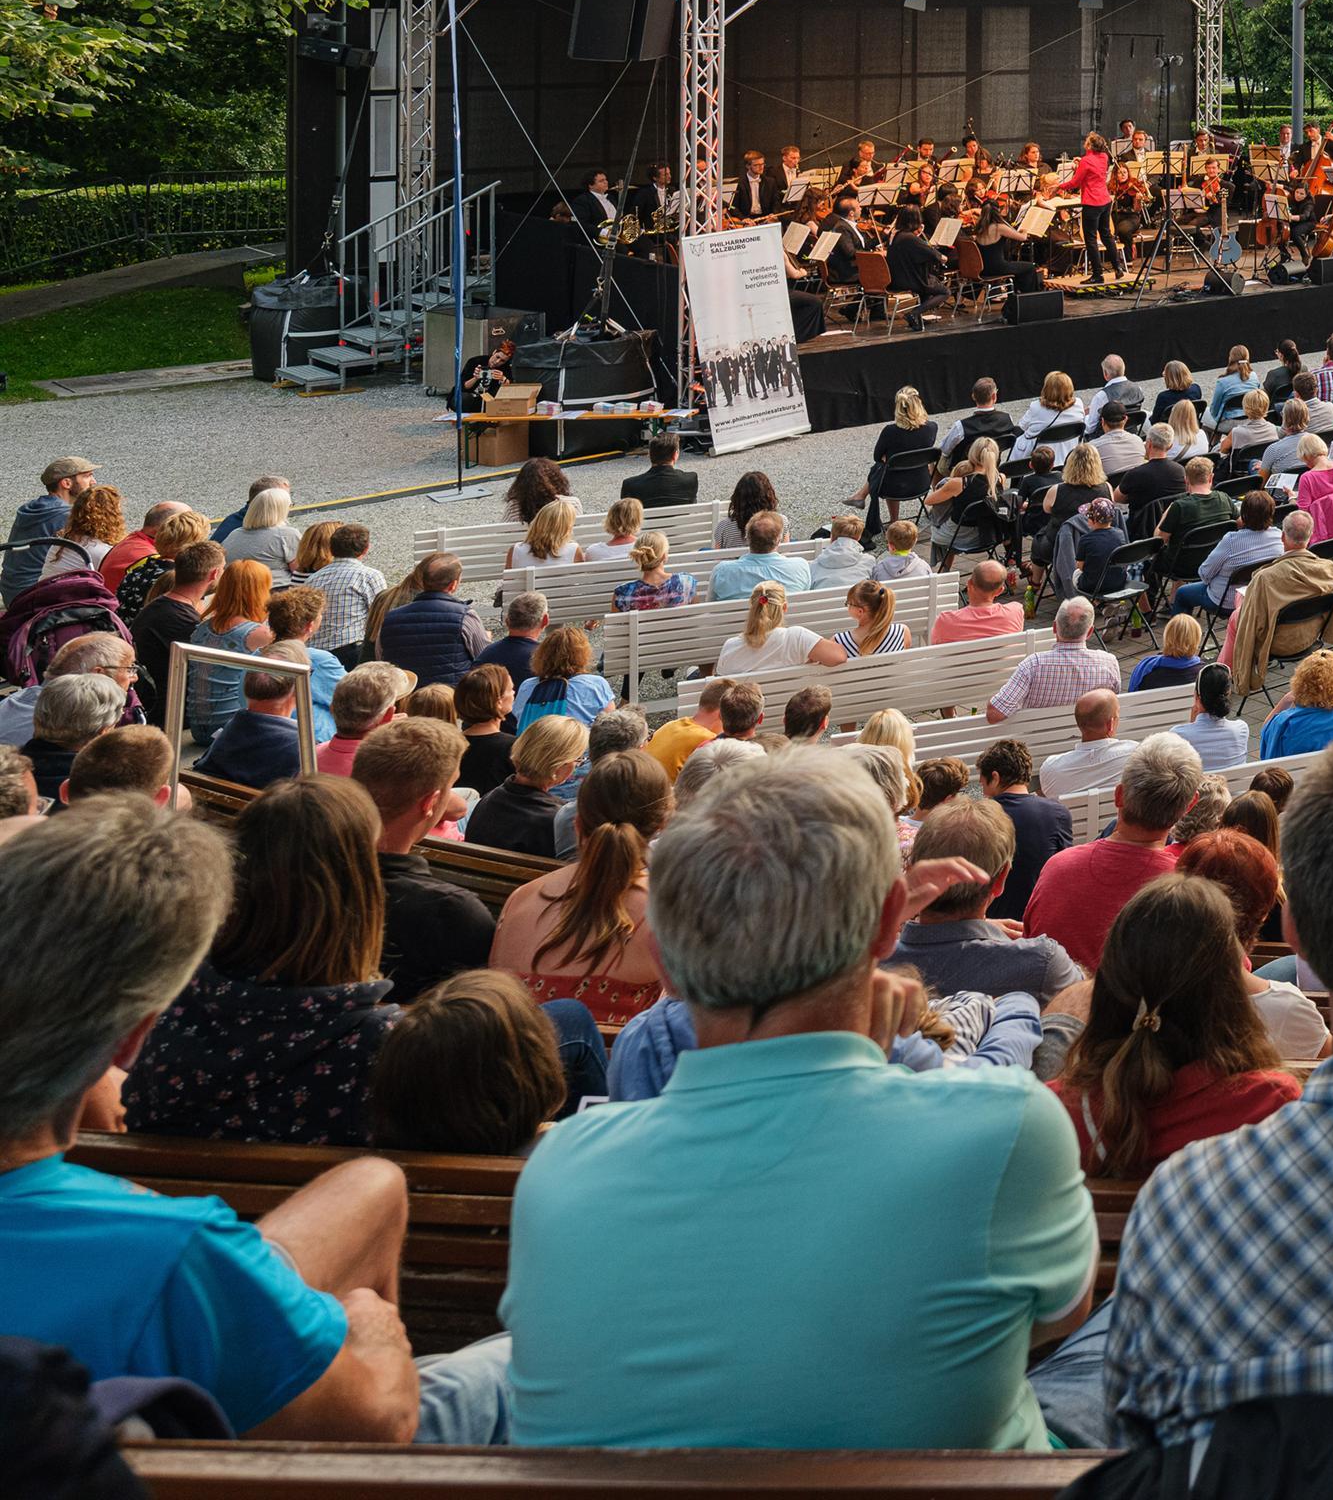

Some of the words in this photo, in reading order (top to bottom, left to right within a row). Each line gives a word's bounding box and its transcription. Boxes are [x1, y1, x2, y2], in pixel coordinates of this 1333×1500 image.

[709, 235, 761, 249] PHILHARMONIE
[710, 244, 746, 254] SALZBURG
[741, 264, 778, 275] mitreißend.
[749, 272, 779, 281] vielseitig.
[744, 279, 780, 290] berührend.
[714, 402, 804, 428] www.philharmoniesalzburg.at
